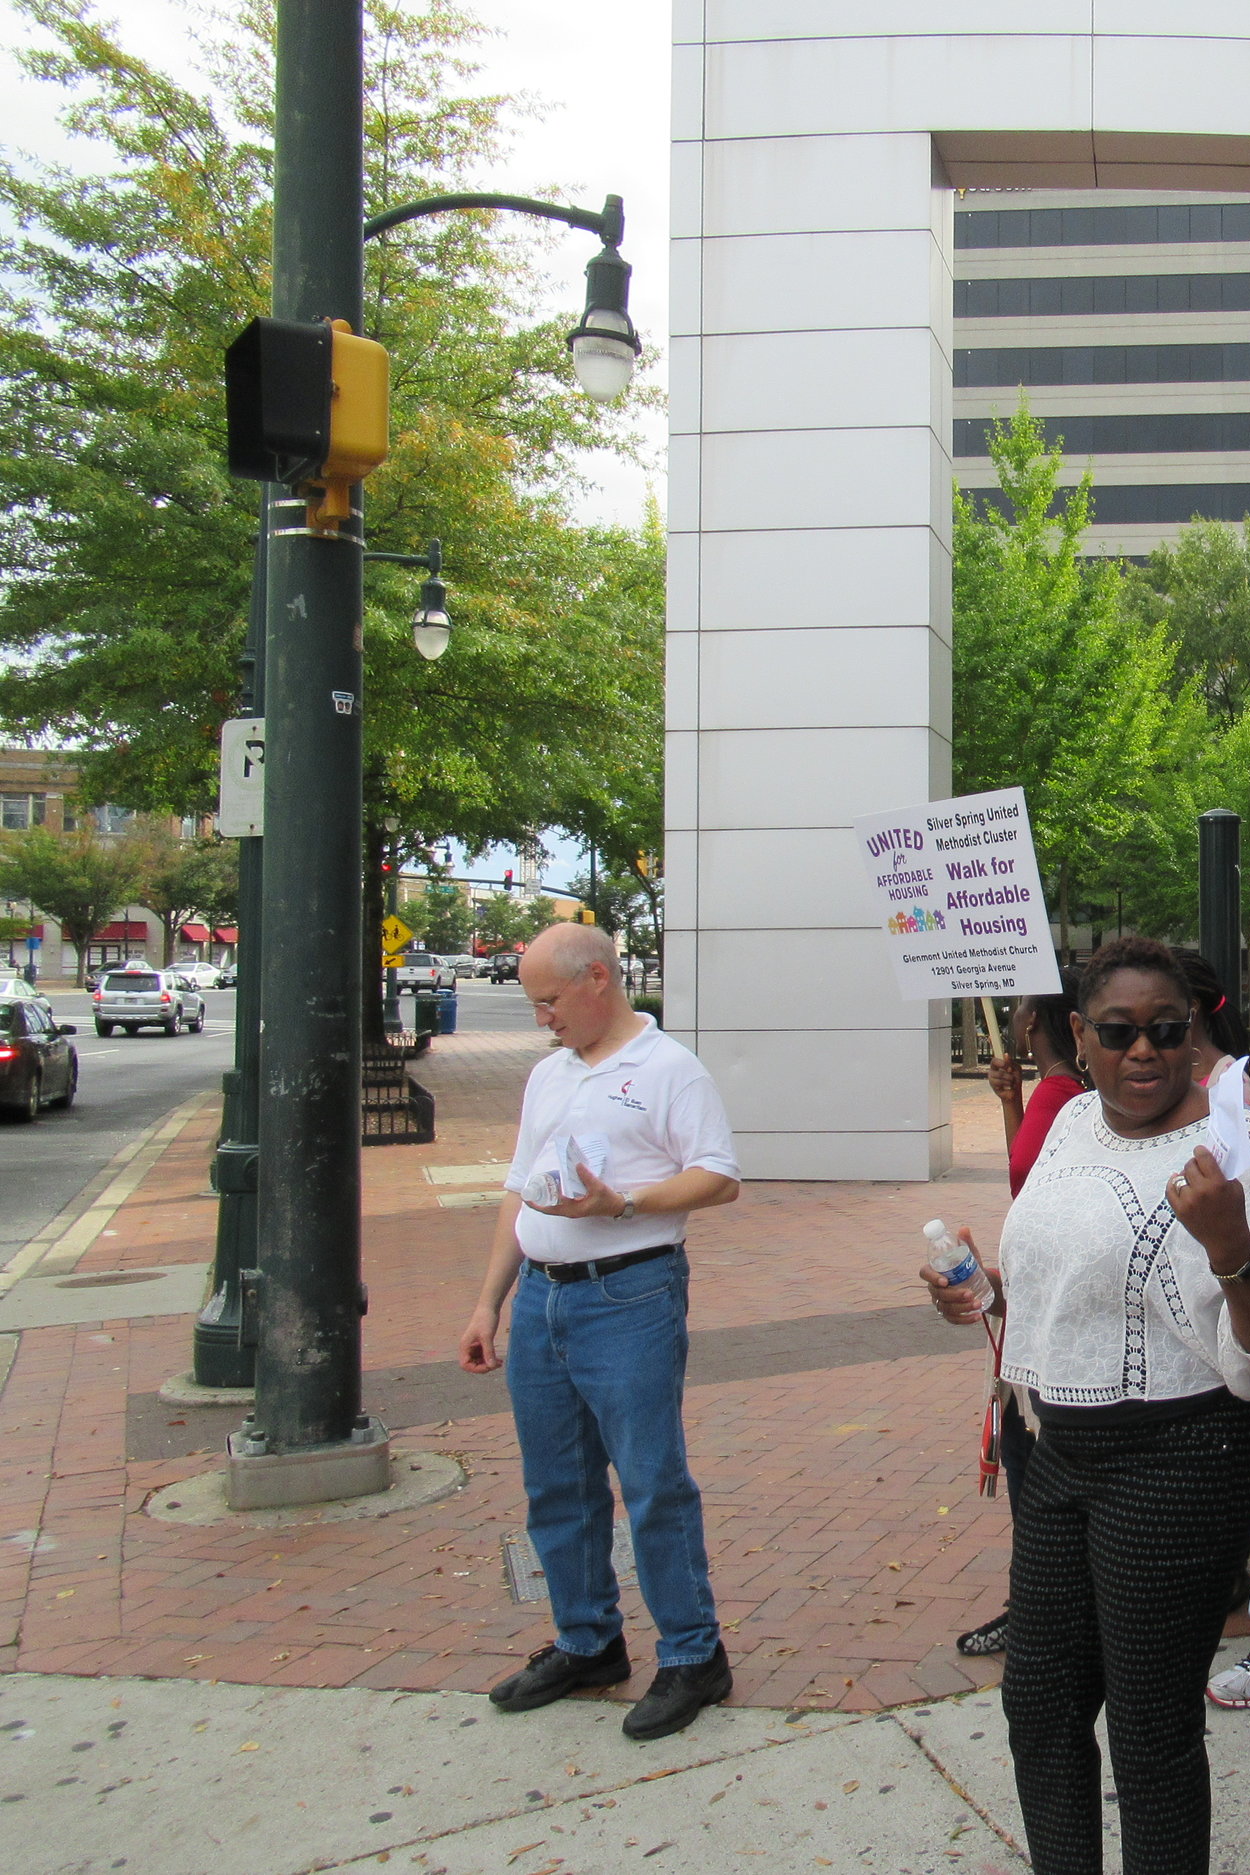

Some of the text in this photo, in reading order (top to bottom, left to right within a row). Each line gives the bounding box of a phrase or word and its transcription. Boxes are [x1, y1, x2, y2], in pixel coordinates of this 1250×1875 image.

[926, 804, 1019, 831] Silver Spring United
[866, 828, 924, 857] UNITED
[936, 829, 1018, 851] Methodist Cluster
[893, 851, 907, 871] for
[946, 856, 1015, 881] Walk for
[877, 868, 933, 888] AFFORDABLE
[888, 884, 929, 901] HOUSING
[946, 884, 1031, 910] Affordable
[960, 915, 1028, 937] Housing
[903, 944, 1038, 964] Glenmont United Methodist Church
[956, 964, 986, 976] Georgia
[988, 963, 1016, 974] Avenue
[951, 978, 1015, 991] Silver Spring, MD
